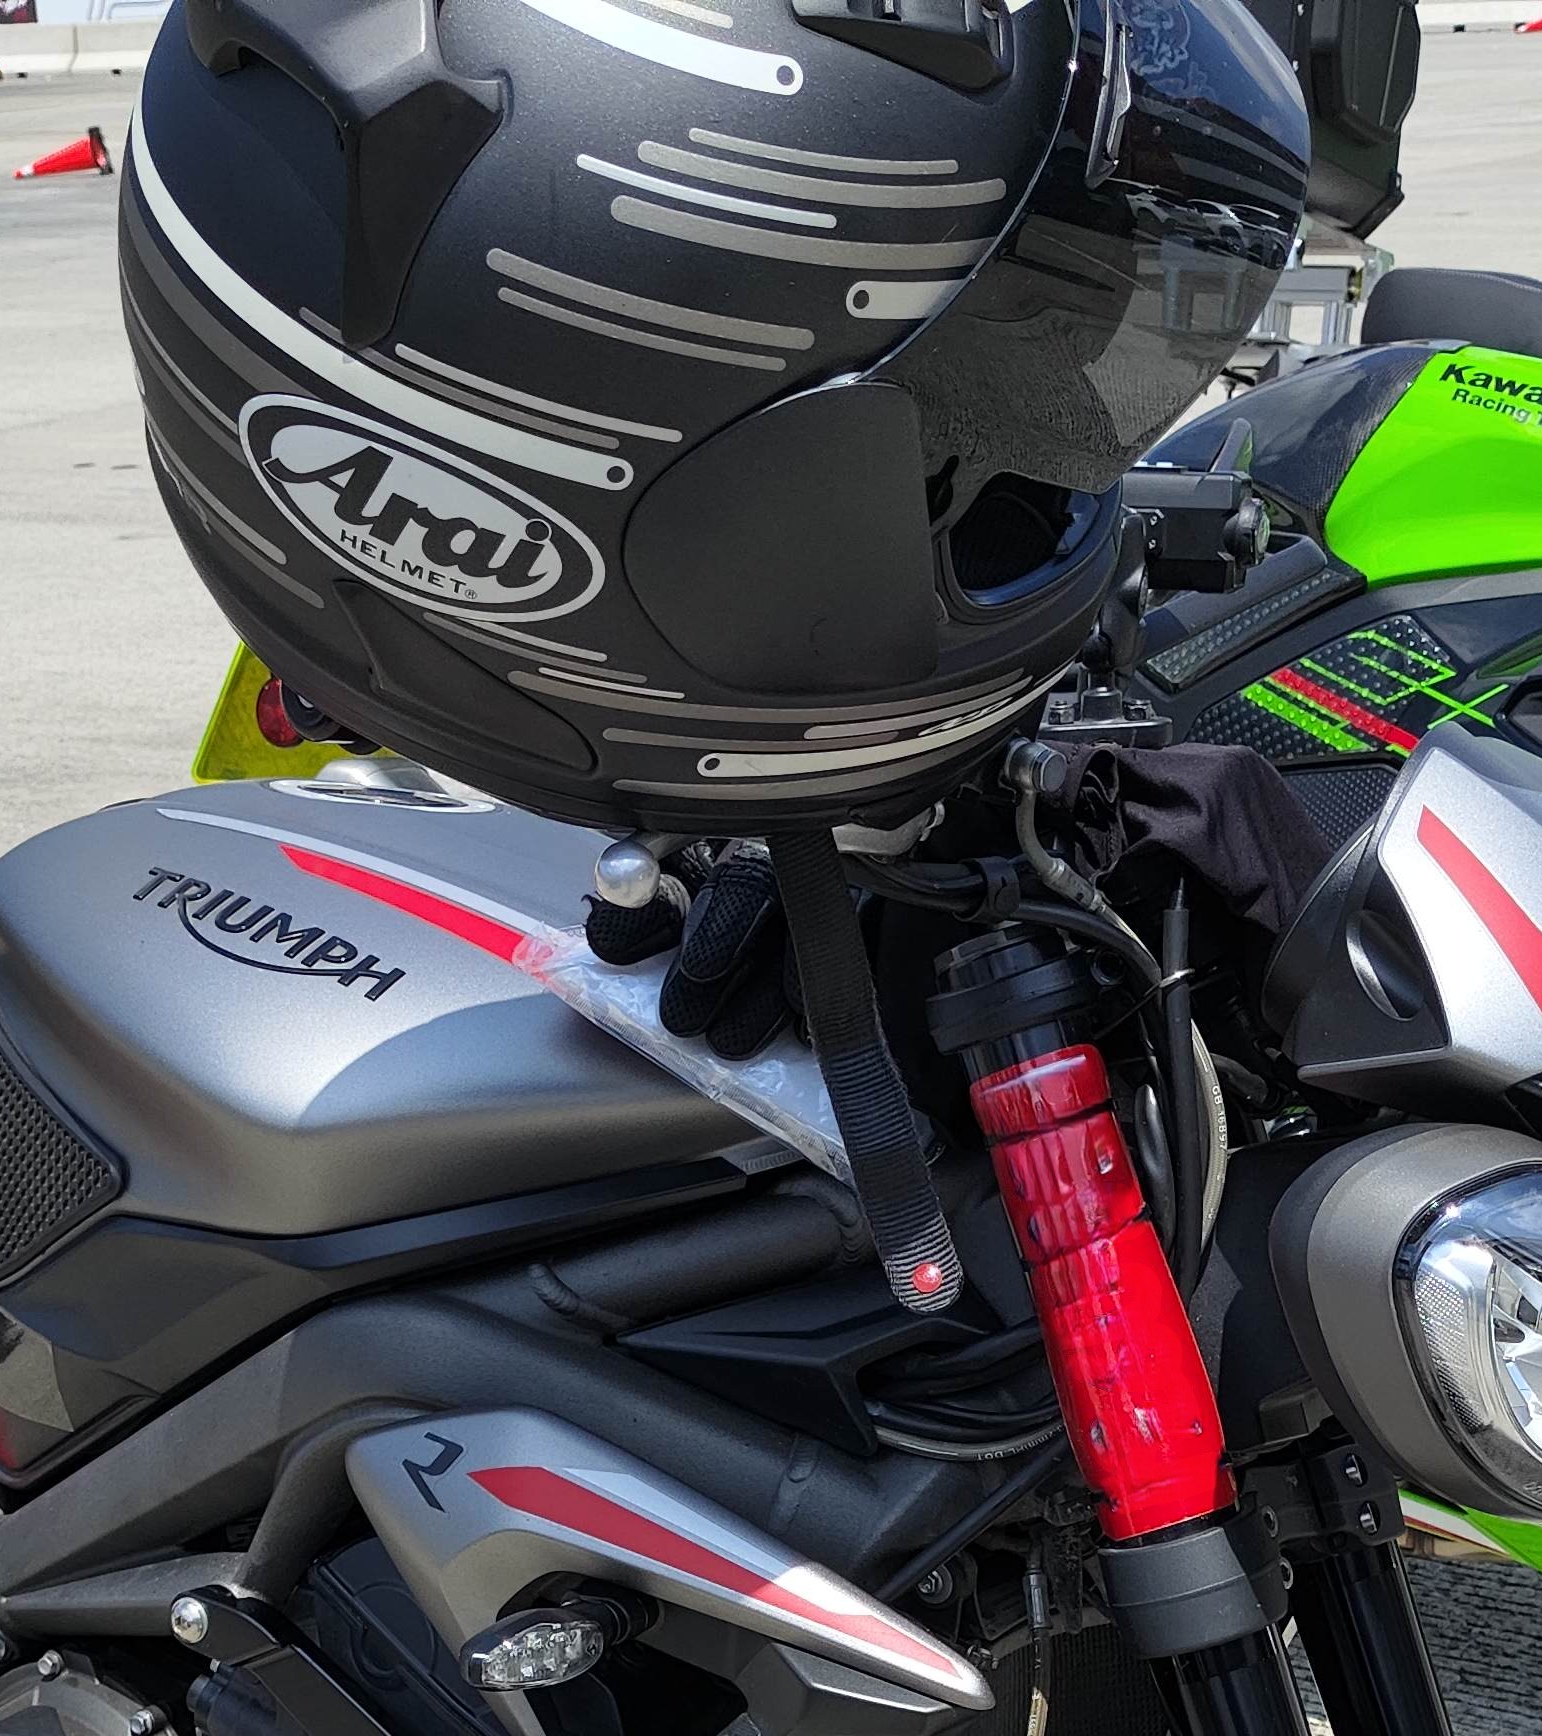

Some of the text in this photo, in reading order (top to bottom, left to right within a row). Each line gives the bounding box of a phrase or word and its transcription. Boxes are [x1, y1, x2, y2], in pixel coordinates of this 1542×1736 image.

[1452, 388, 1531, 423] Racing
[262, 446, 551, 588] Arai
[340, 528, 467, 596] HELMET
[133, 867, 406, 1001] TRIUMPH
